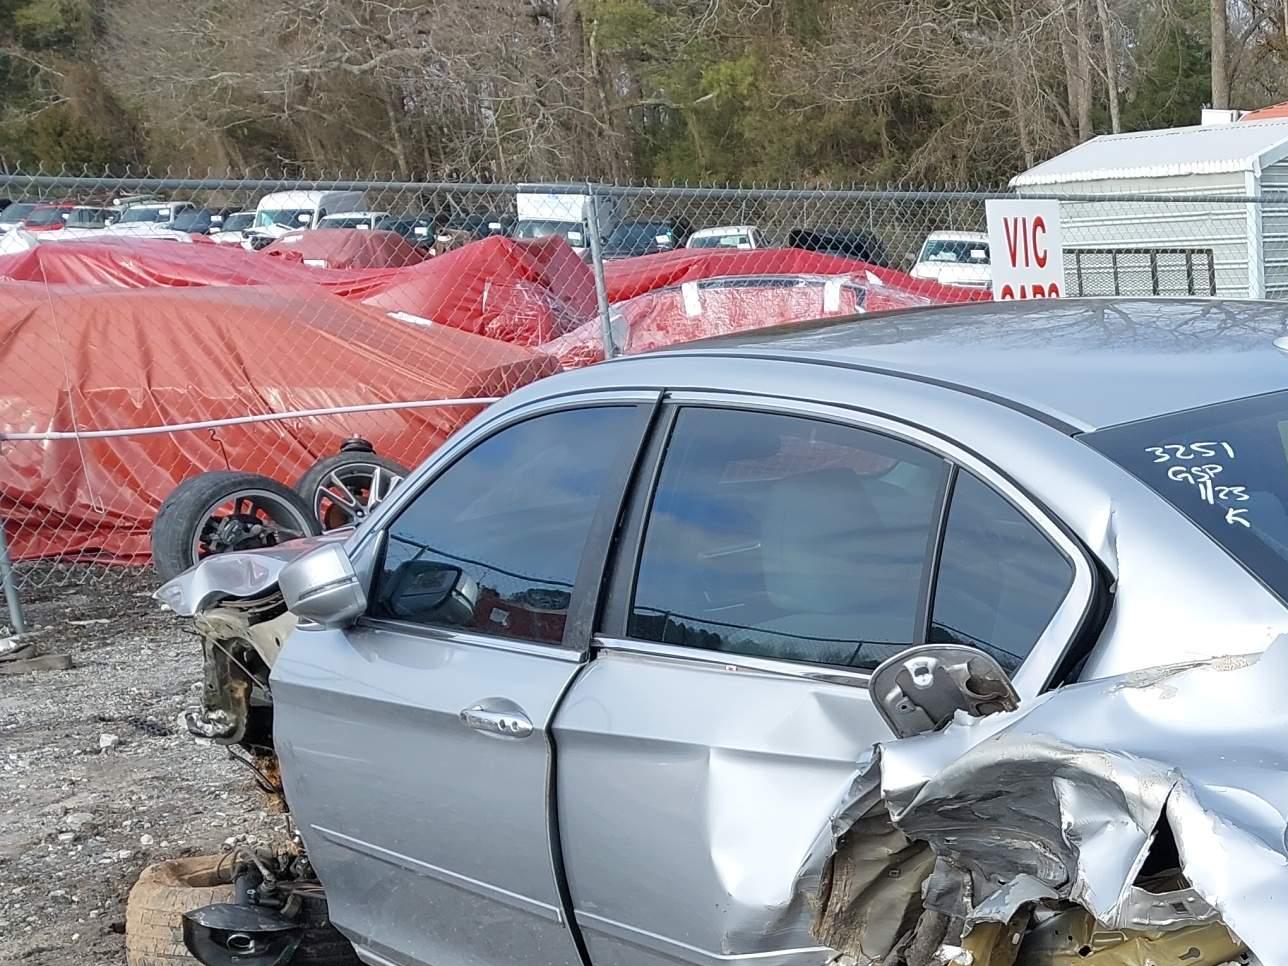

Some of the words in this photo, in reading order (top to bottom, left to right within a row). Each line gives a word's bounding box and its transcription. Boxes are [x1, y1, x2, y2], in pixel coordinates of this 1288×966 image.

[1003, 216, 1048, 267] VIC
[1145, 442, 1235, 463] 3251
[1167, 464, 1223, 484] GSP
